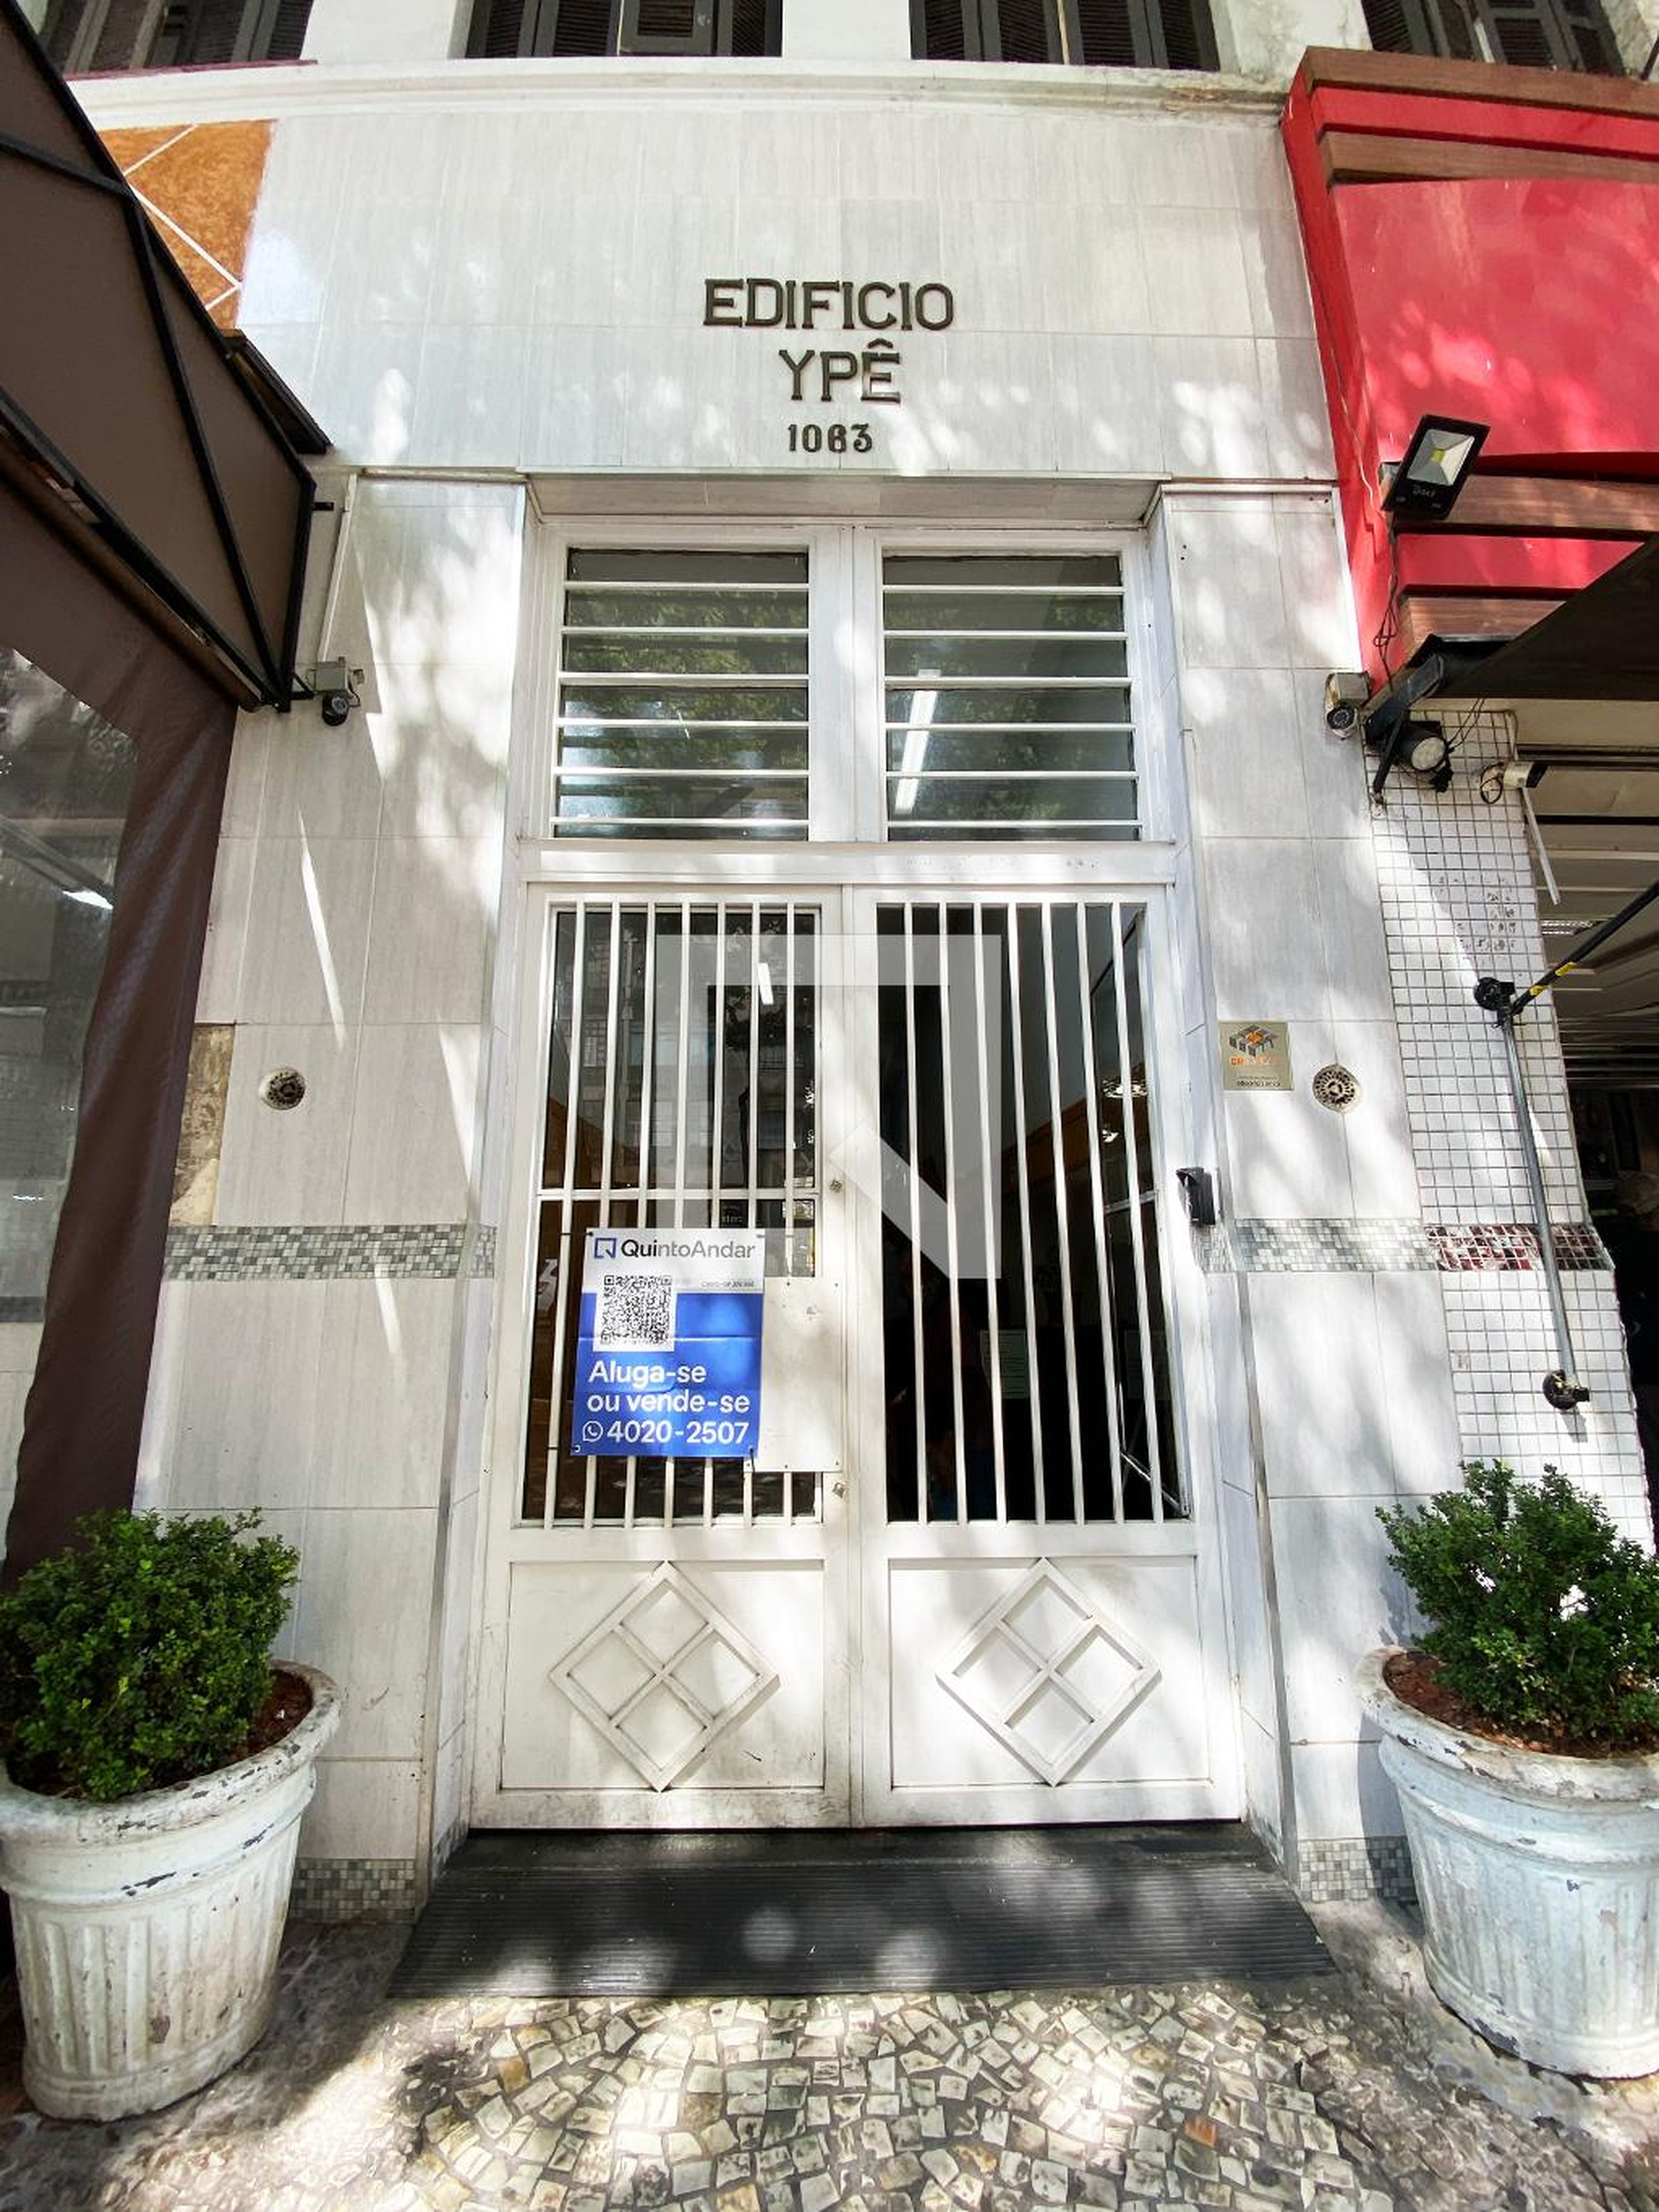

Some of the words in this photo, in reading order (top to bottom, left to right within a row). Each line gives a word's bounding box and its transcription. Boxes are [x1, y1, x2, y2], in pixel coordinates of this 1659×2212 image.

[703, 278, 953, 331] EDIFICIO
[779, 338, 901, 403] YPÊ
[788, 424, 872, 453] 1063
[621, 1239, 756, 1258] QuintoAndar
[588, 1360, 707, 1388] Aluga-se
[587, 1394, 620, 1413] ou
[627, 1390, 750, 1413] vende-se
[607, 1420, 749, 1444] 4020-2507
